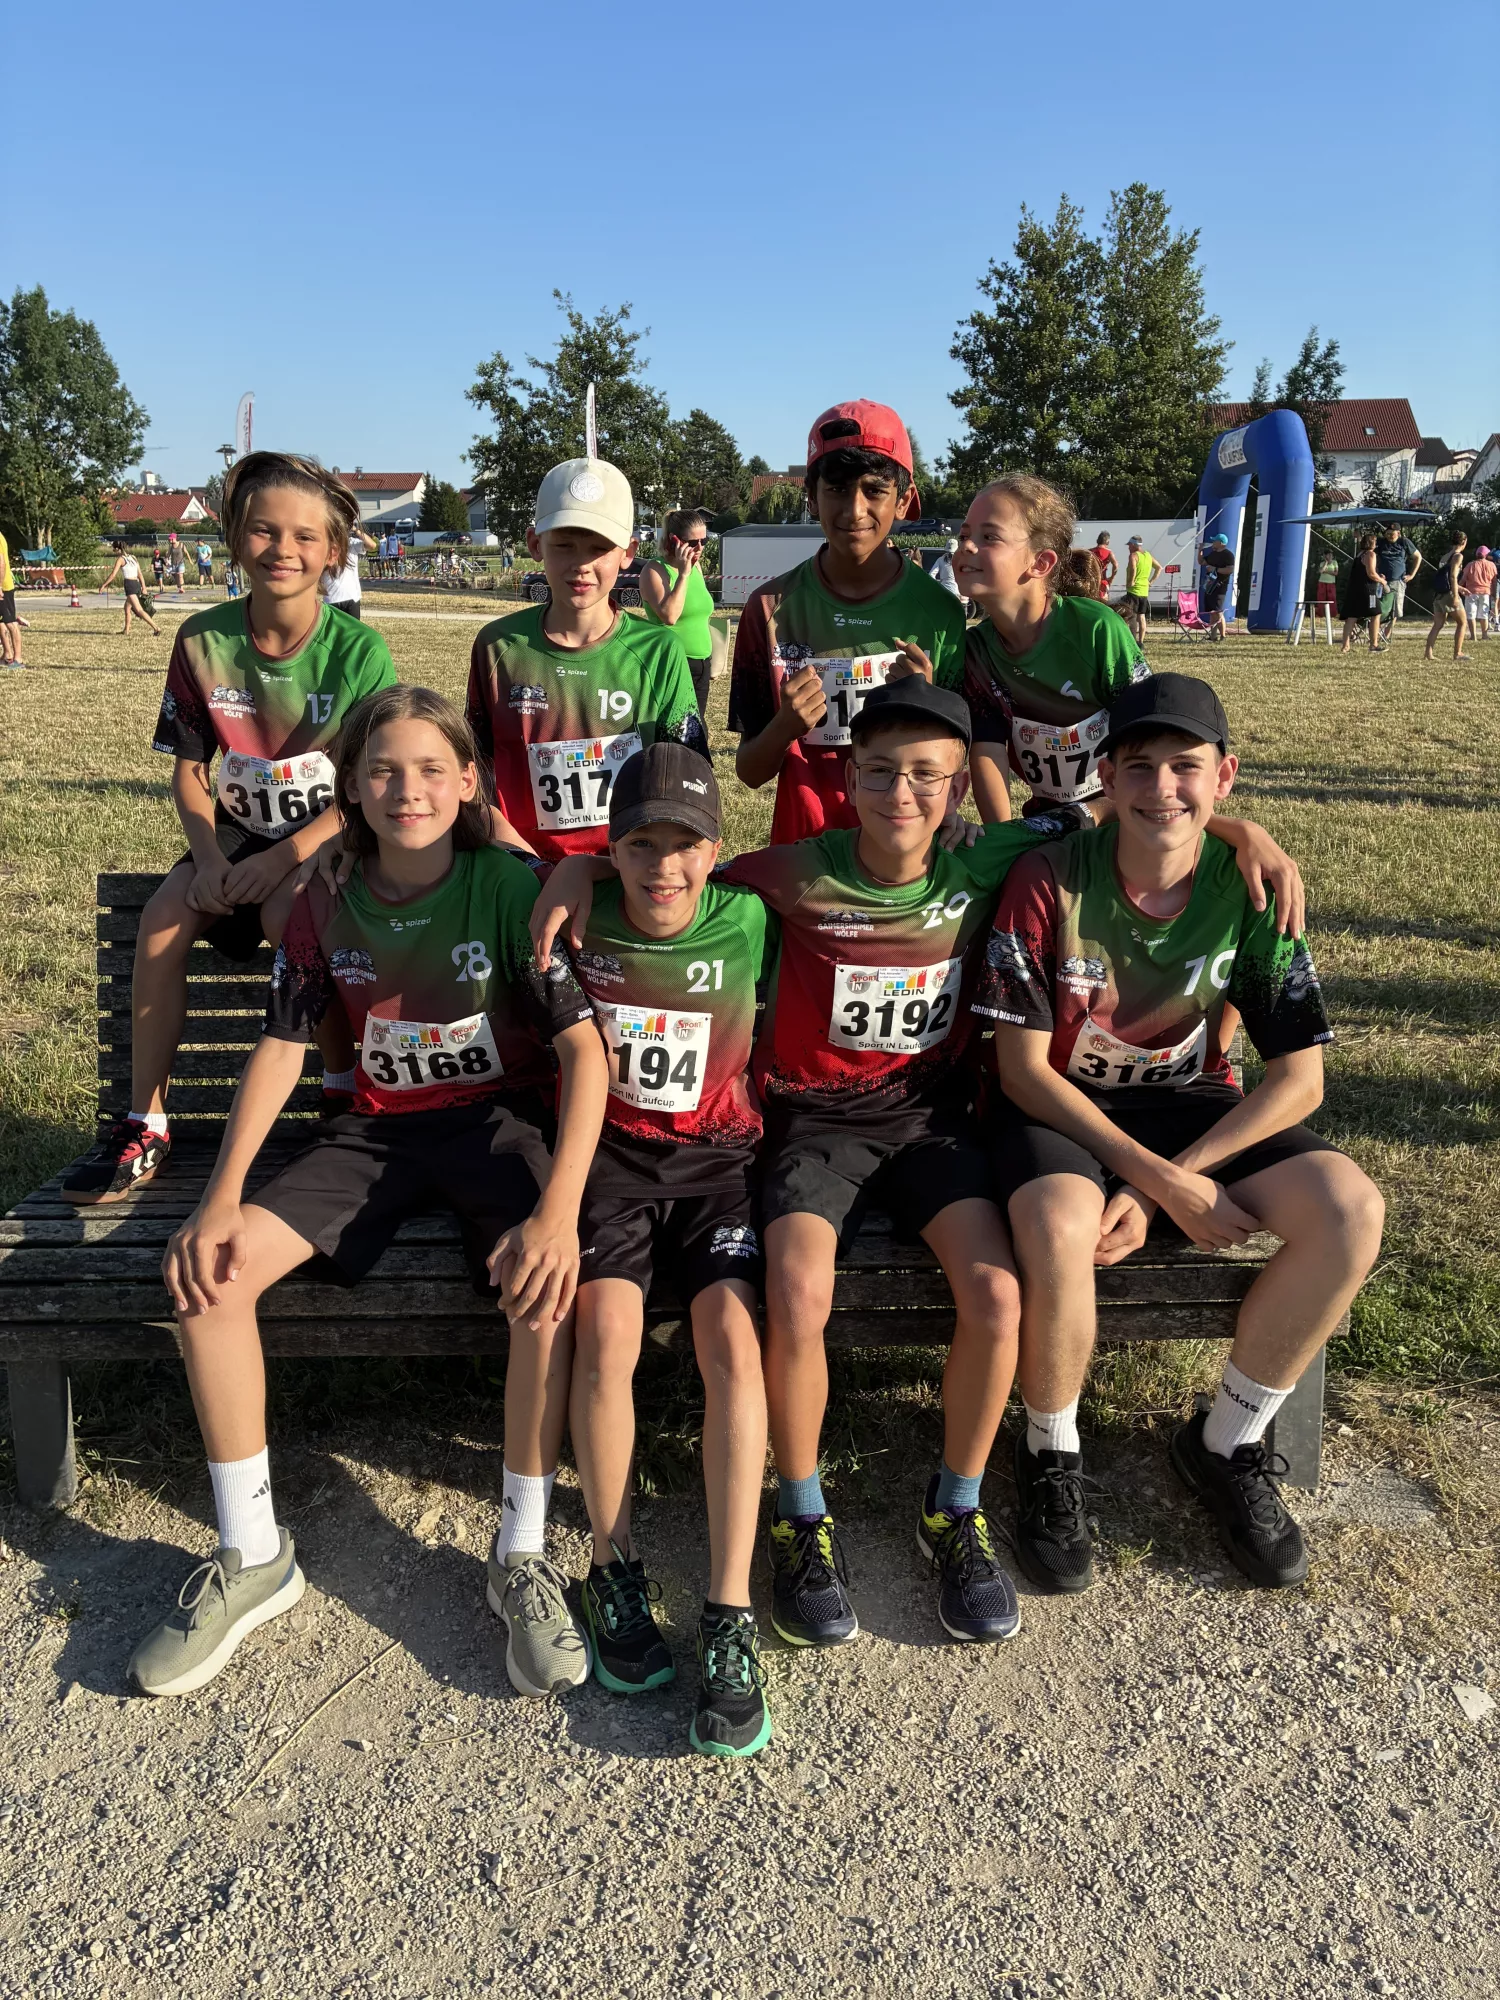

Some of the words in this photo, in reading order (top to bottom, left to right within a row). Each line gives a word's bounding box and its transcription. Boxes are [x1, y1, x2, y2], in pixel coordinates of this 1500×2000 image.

[848, 618, 872, 626] spized
[272, 674, 293, 682] spized
[836, 677, 872, 686] LEDIN
[208, 702, 256, 714] GAIMERSHEIMER
[307, 693, 334, 724] 13
[598, 689, 632, 720] 19
[223, 709, 244, 719] WÖLFE
[824, 733, 844, 742] Sport
[1046, 743, 1082, 752] LEDIN
[567, 759, 604, 768] LEDIN
[255, 778, 294, 786] LEDIN
[538, 769, 612, 812] 317
[1072, 783, 1103, 797] Laufcu
[226, 783, 334, 822] 3166
[558, 816, 582, 826] Sport
[250, 822, 270, 835] Sport
[921, 891, 974, 930] 20
[406, 916, 432, 927] spized
[818, 923, 874, 932] GAIMERSHEIMER
[834, 929, 858, 938] WÖLFE
[452, 940, 492, 982] 28
[686, 960, 724, 993] 21
[1184, 950, 1237, 997] 10
[884, 988, 925, 996] LEDIN
[840, 993, 952, 1038] 3192
[620, 1030, 664, 1042] LEDIN
[400, 1042, 444, 1050] LEDIN
[858, 1041, 884, 1050] Sport
[898, 1040, 932, 1050] Laufcup
[369, 1046, 492, 1085] 3168
[613, 1042, 698, 1092] 194
[1078, 1052, 1199, 1084] 3164
[626, 1090, 634, 1100] IN
[636, 1096, 675, 1108] Laufcup
[710, 1242, 759, 1256] GAIMERSHEIMER
[727, 1248, 750, 1258] WÖLFE
